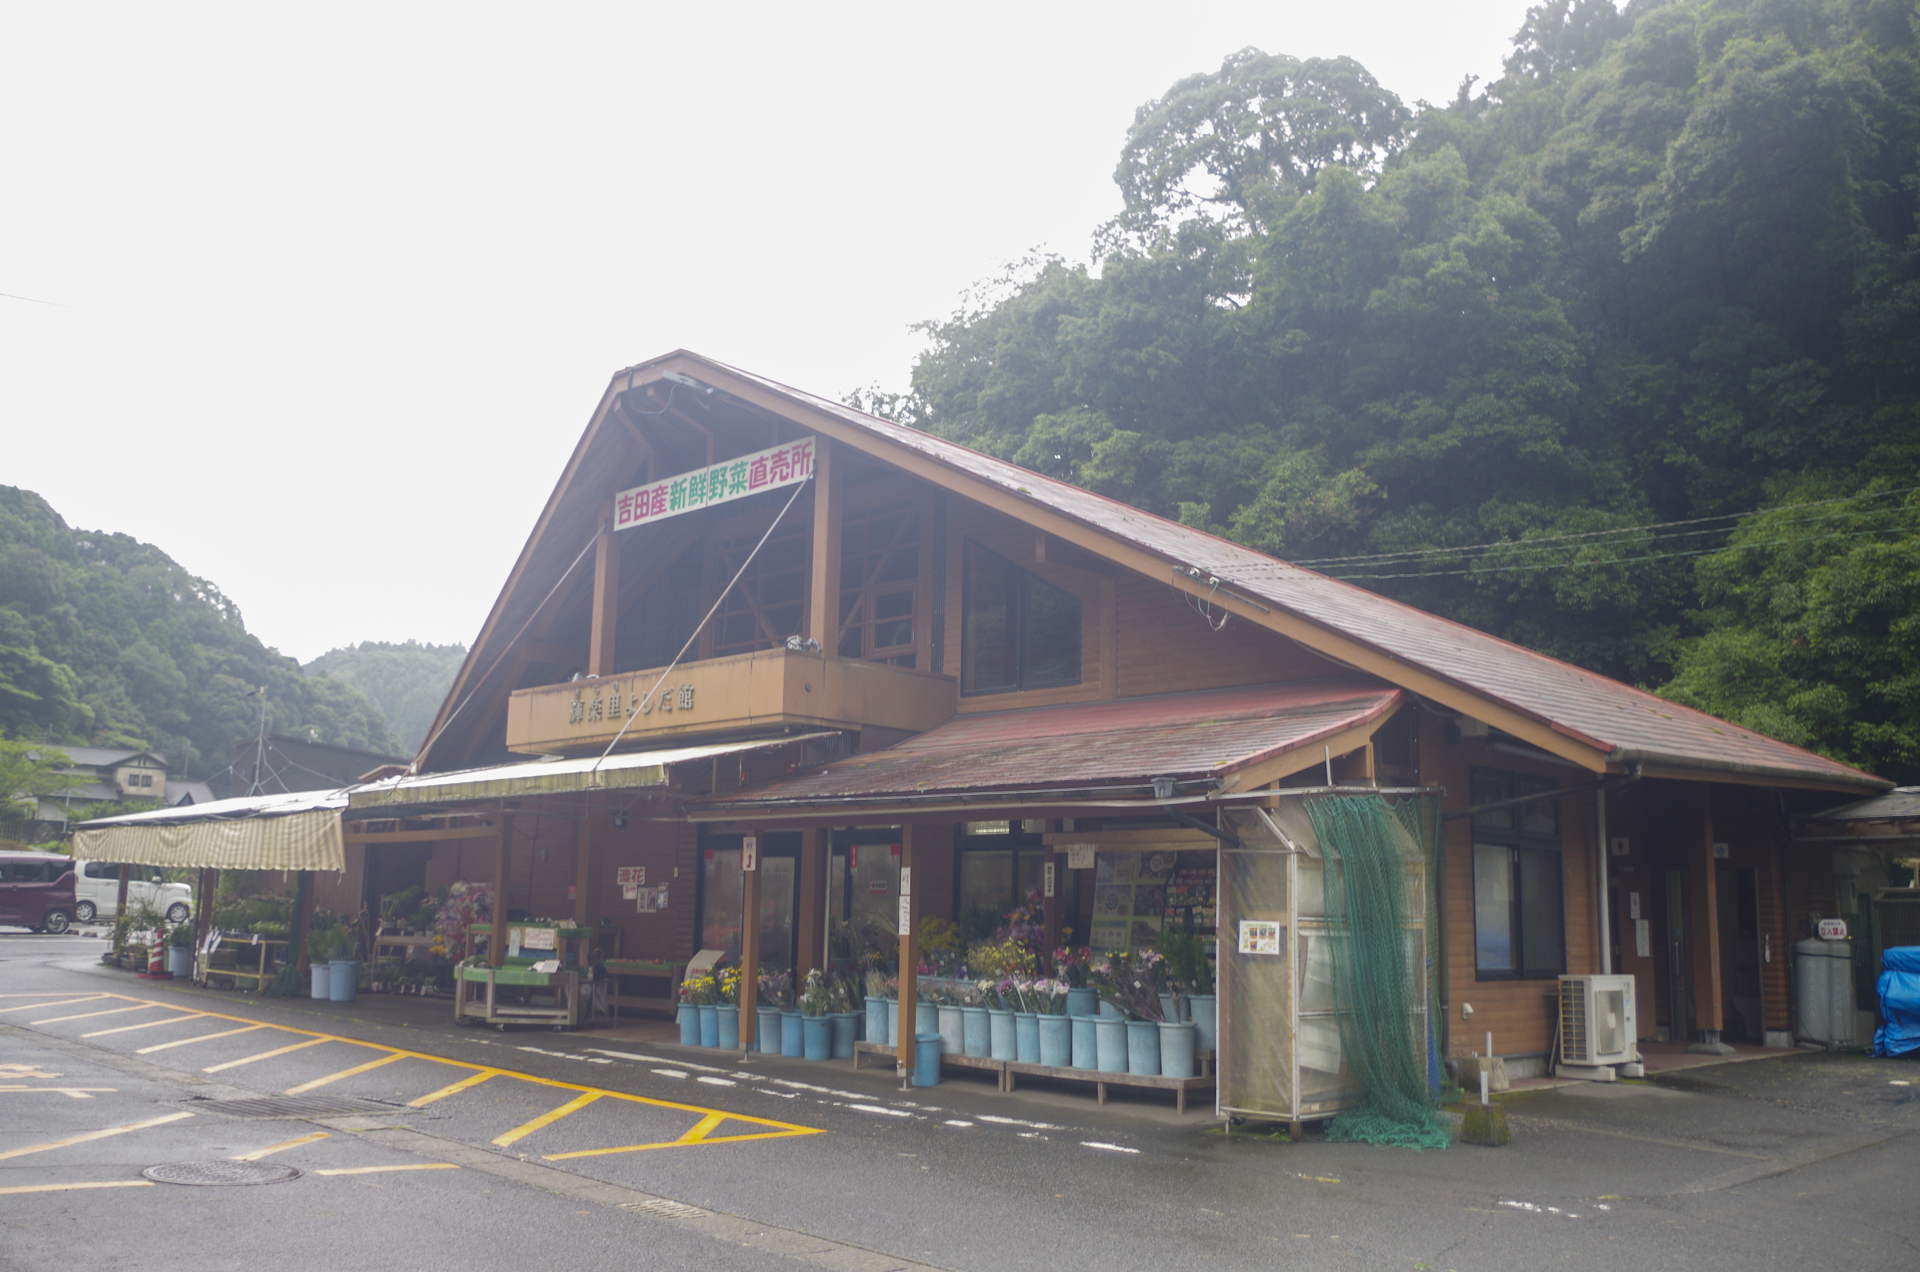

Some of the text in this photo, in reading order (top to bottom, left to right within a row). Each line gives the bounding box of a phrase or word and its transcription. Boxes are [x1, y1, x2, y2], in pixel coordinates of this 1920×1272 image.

[617, 441, 812, 525] 吉田産新鮮野菜直売所
[619, 868, 644, 883] 造花
[1820, 927, 1845, 936] 立入禁止
